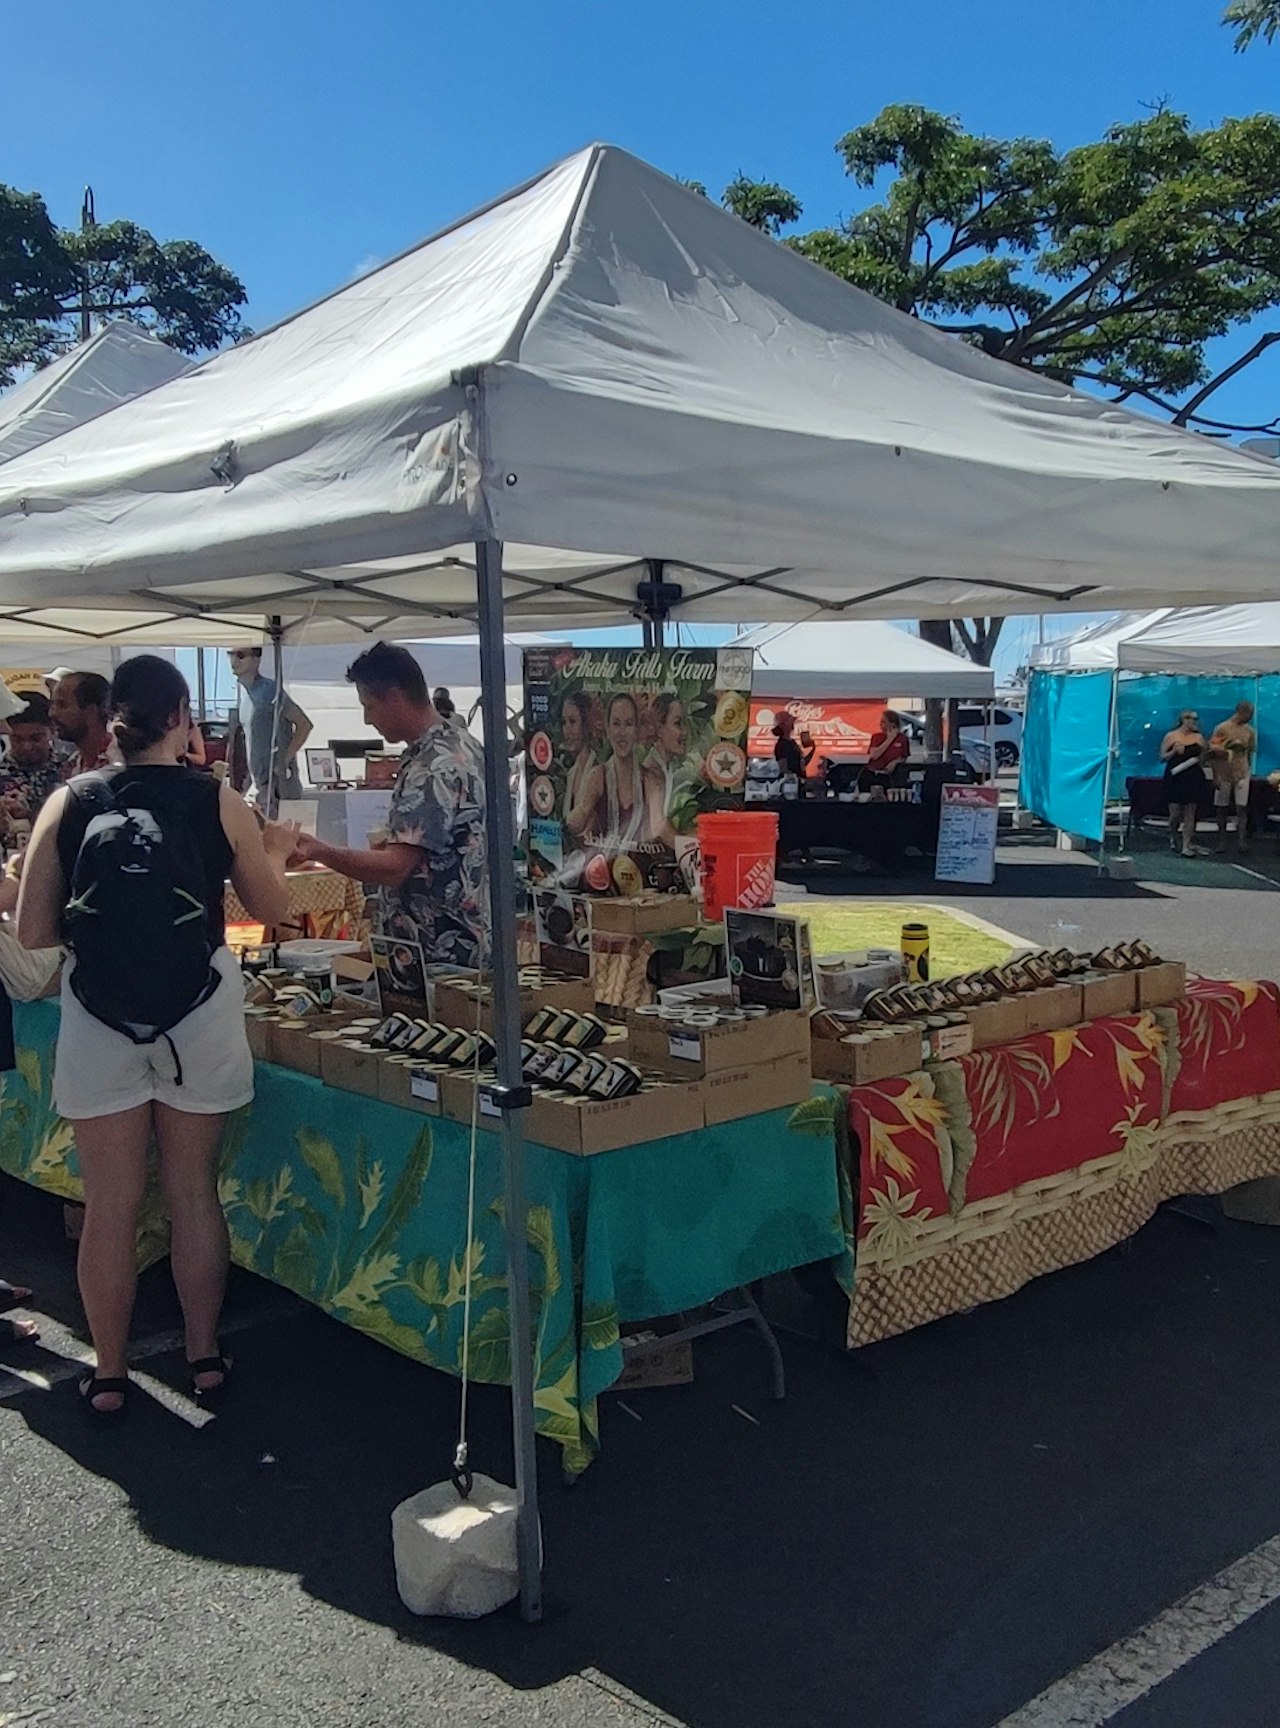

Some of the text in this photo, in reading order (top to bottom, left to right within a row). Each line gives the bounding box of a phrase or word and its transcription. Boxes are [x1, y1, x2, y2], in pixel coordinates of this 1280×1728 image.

[562, 650, 619, 679] Akaka
[621, 650, 663, 679] Falls
[667, 650, 716, 681] Farm
[744, 859, 766, 882] THE
